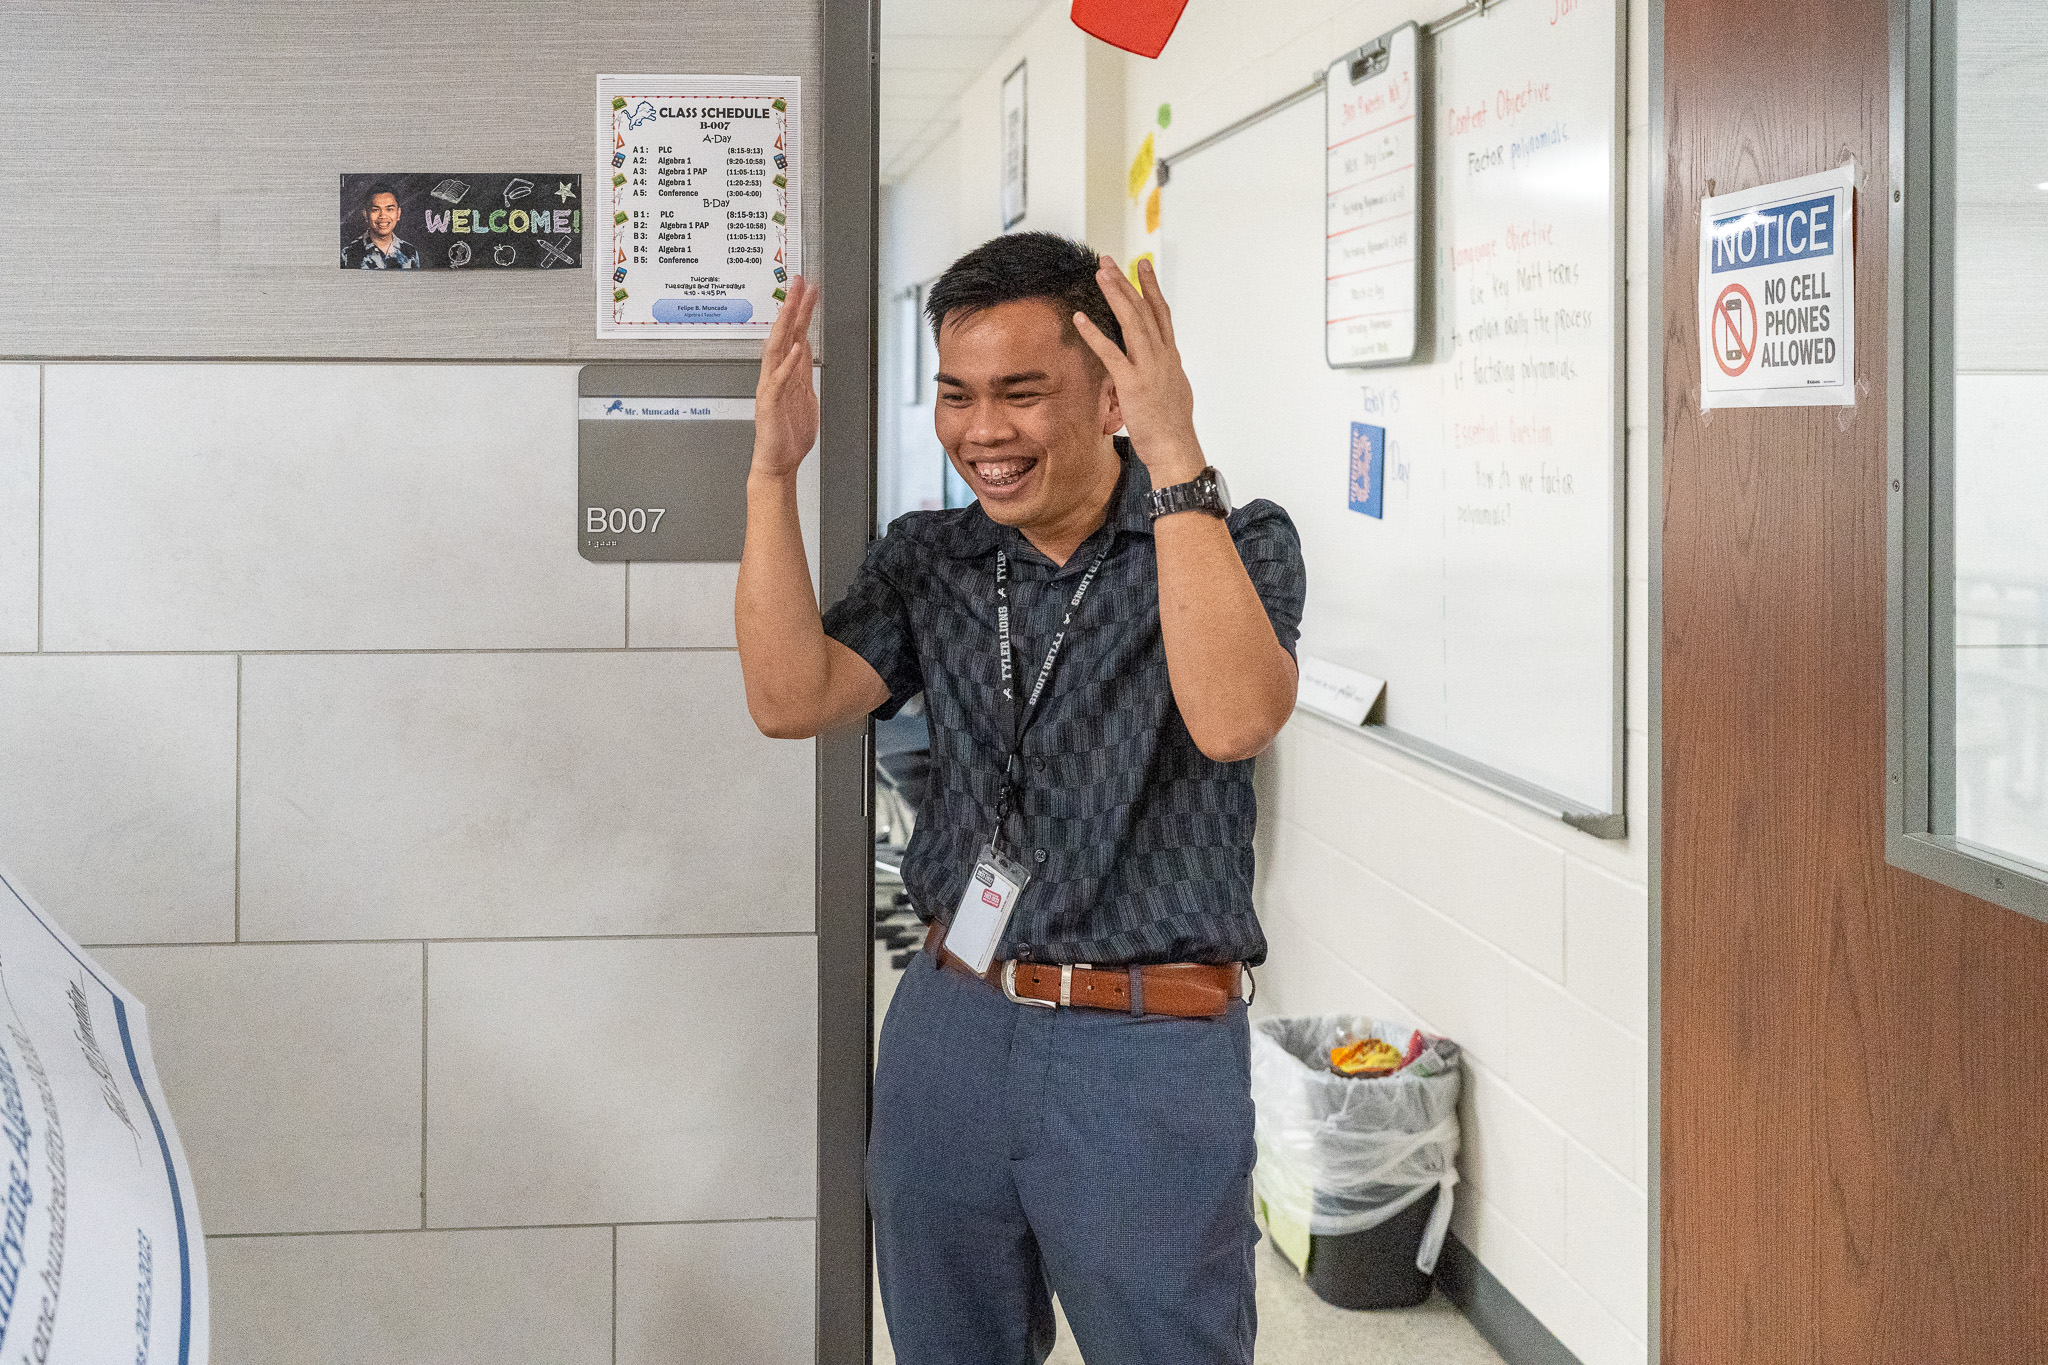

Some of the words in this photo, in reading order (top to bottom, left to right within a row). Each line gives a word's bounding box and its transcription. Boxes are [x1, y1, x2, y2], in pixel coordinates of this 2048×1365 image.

[1496, 79, 1551, 128] Objective
[659, 107, 698, 118] CLASS
[701, 107, 770, 119] SCHEDULE
[699, 121, 731, 130] B-007
[702, 134, 732, 144] A-Day
[727, 147, 763, 155] (8:15-9:13)
[658, 157, 686, 166] Algebra
[726, 158, 766, 166] (9:20-10:58)
[658, 168, 686, 176] Algebra
[658, 178, 686, 187] Algebra
[633, 189, 639, 197] A
[658, 189, 699, 197] Conference
[726, 190, 762, 198] (3:00-4:00)
[702, 198, 730, 208] B-Day
[726, 211, 768, 220] (8:15-9:13)
[424, 209, 581, 234] WELCOME!
[660, 222, 688, 230] Algebra
[727, 222, 767, 230] (9:20-10:58)
[658, 232, 686, 241] Algebra
[1717, 204, 1829, 267] NOTICE
[658, 245, 686, 254] Algebra
[728, 246, 764, 254] (1:20-2:53)
[633, 256, 639, 264] B
[658, 256, 699, 264] Conference
[726, 257, 762, 265] (3:00-4:00)
[1764, 278, 1786, 305] NO
[1790, 271, 1831, 300] CELL
[1765, 304, 1831, 337] PHONES
[1761, 337, 1836, 368] ALLOWED
[624, 407, 639, 416] Mr.
[641, 407, 680, 416] Muncada
[689, 407, 711, 416] Math
[586, 507, 666, 533] B007
[1071, 573, 1094, 606] LIONS
[998, 606, 1009, 640] LIONS
[1045, 631, 1065, 669] TYLER
[1000, 640, 1013, 681] TYLER
[1029, 668, 1049, 706] LIONS
[40, 1165, 67, 1300] hundred
